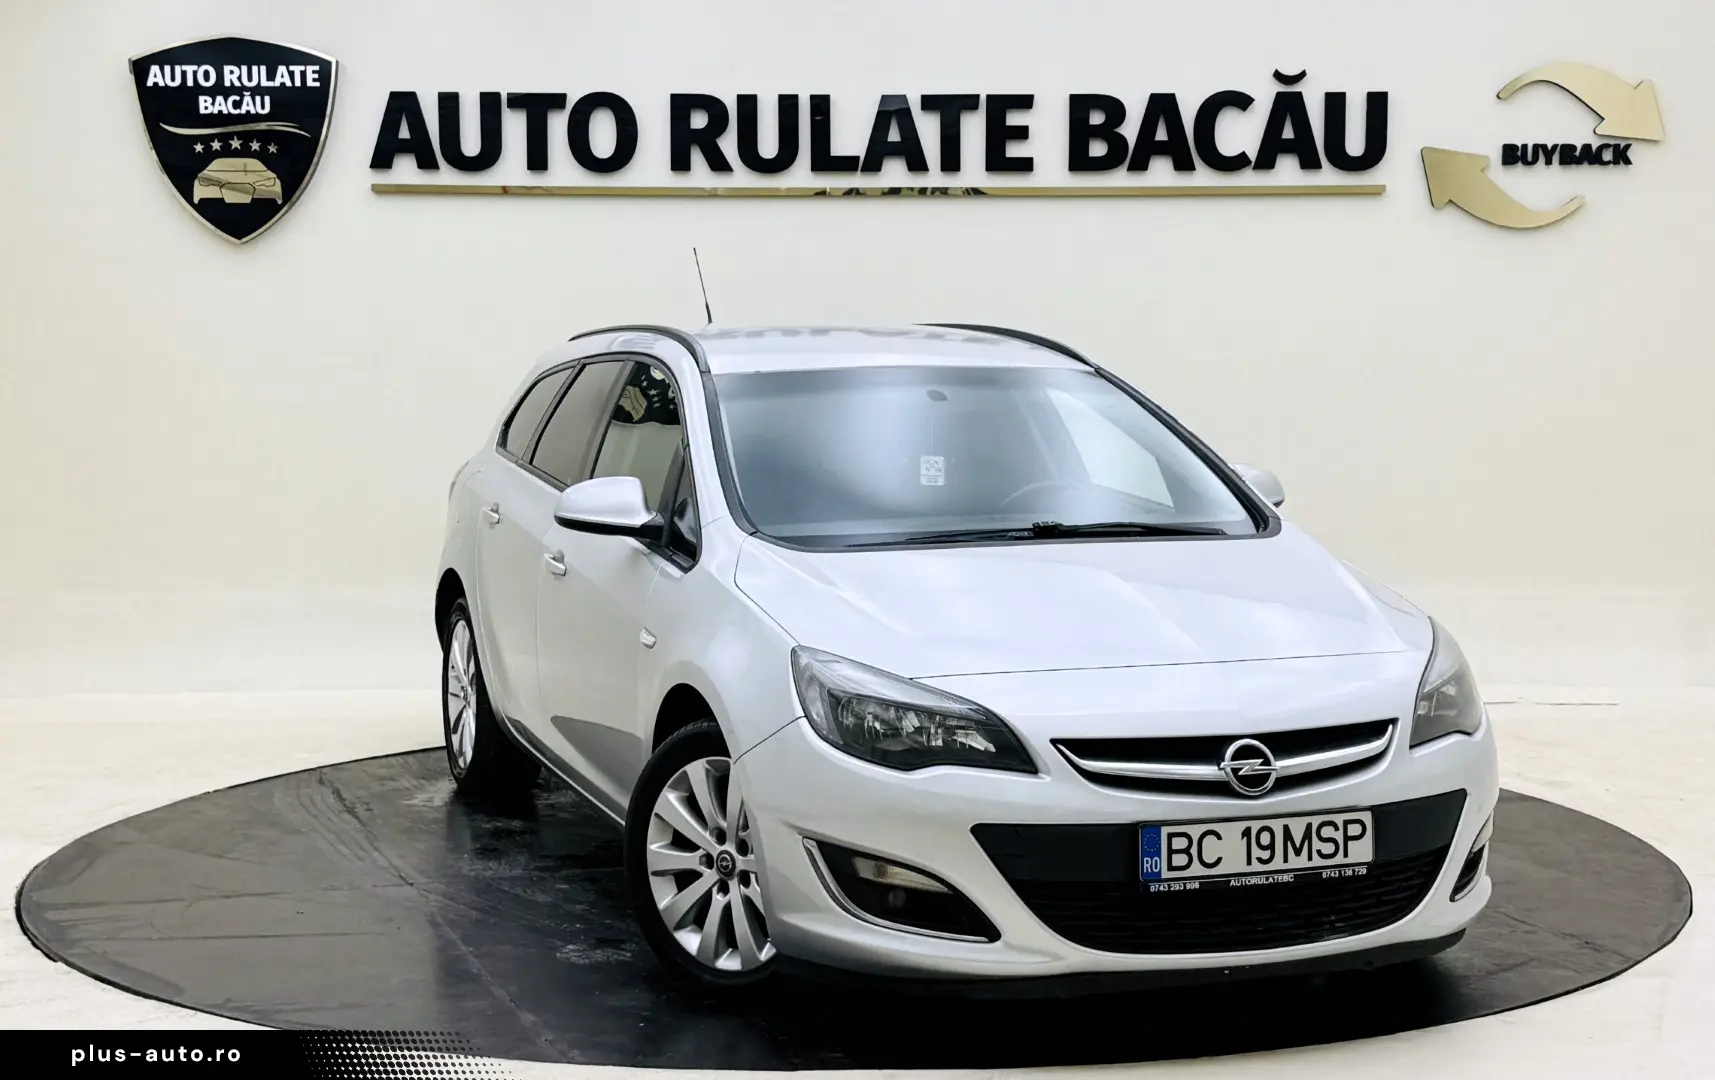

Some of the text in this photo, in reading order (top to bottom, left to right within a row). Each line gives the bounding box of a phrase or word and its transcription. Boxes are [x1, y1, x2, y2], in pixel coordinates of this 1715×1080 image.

[146, 64, 321, 87] AUTO RULATE
[198, 91, 271, 114] BACĂU
[369, 68, 1389, 174] AUTO RULATE BACĂU
[1501, 143, 1633, 166] BUYBACK
[1166, 829, 1223, 872] BC
[1143, 857, 1160, 873] RO
[1229, 875, 1295, 887] AUTORULATEBC
